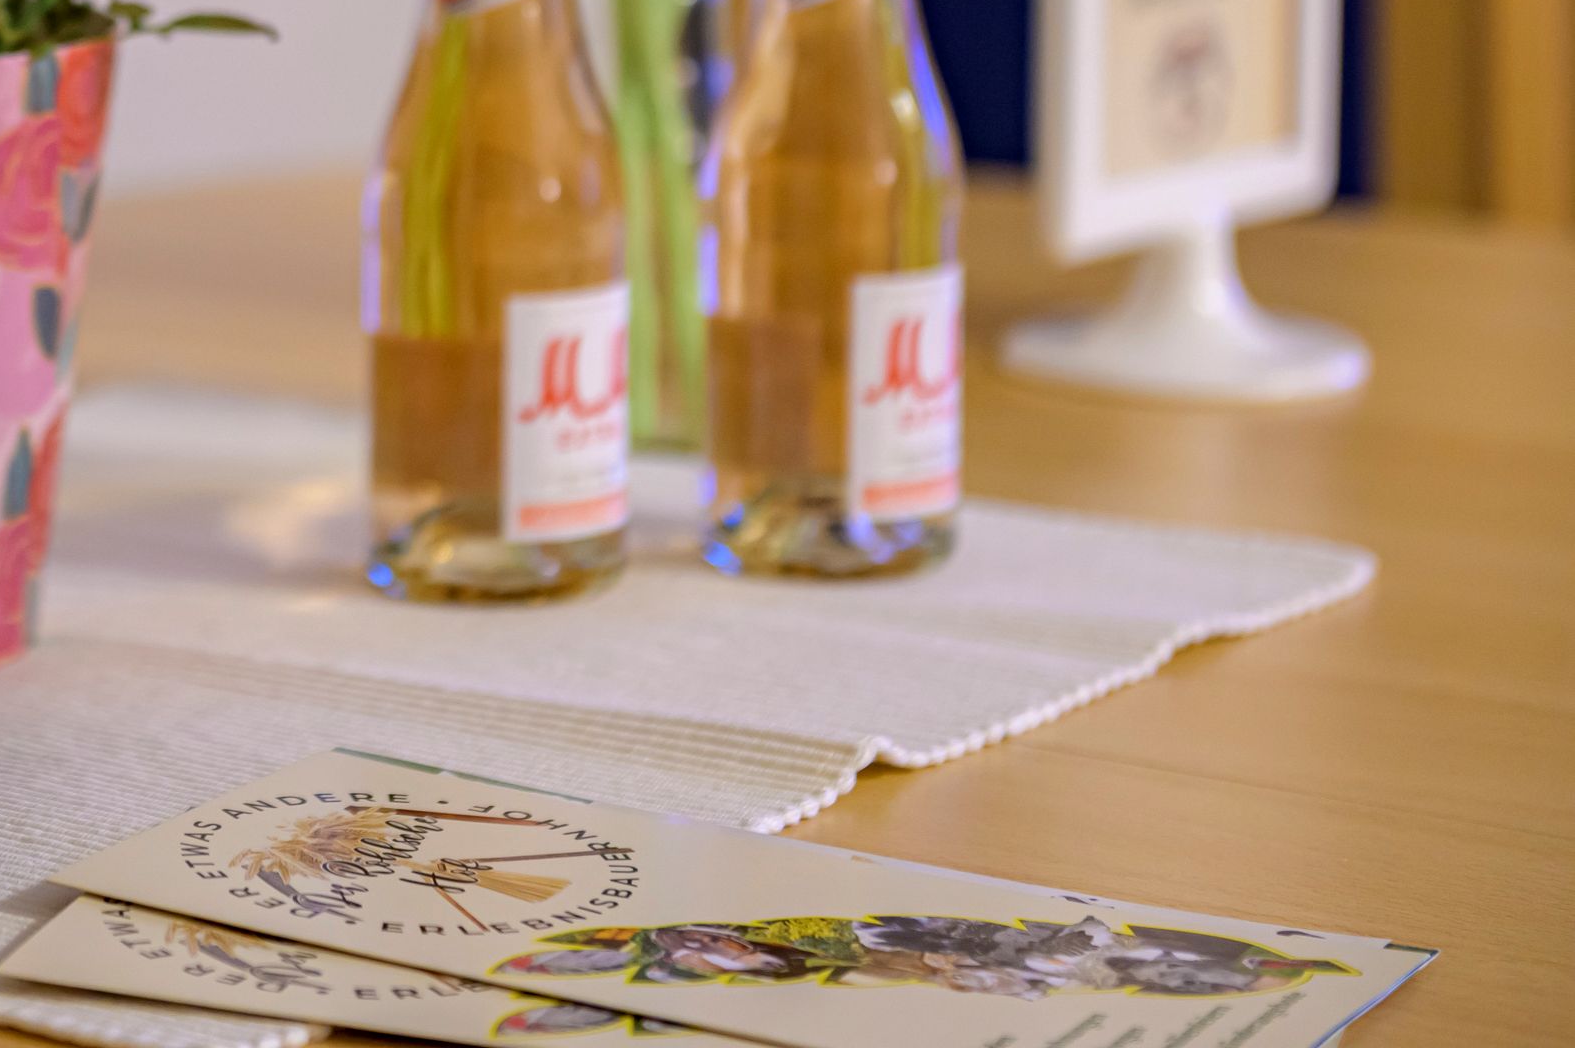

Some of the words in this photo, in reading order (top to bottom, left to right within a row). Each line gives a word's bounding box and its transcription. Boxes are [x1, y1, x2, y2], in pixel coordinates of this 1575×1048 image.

[179, 819, 228, 880] ETWAS
[221, 792, 410, 820] ANDERE
[380, 804, 640, 937] ERLEBNISBAUERNHOF
